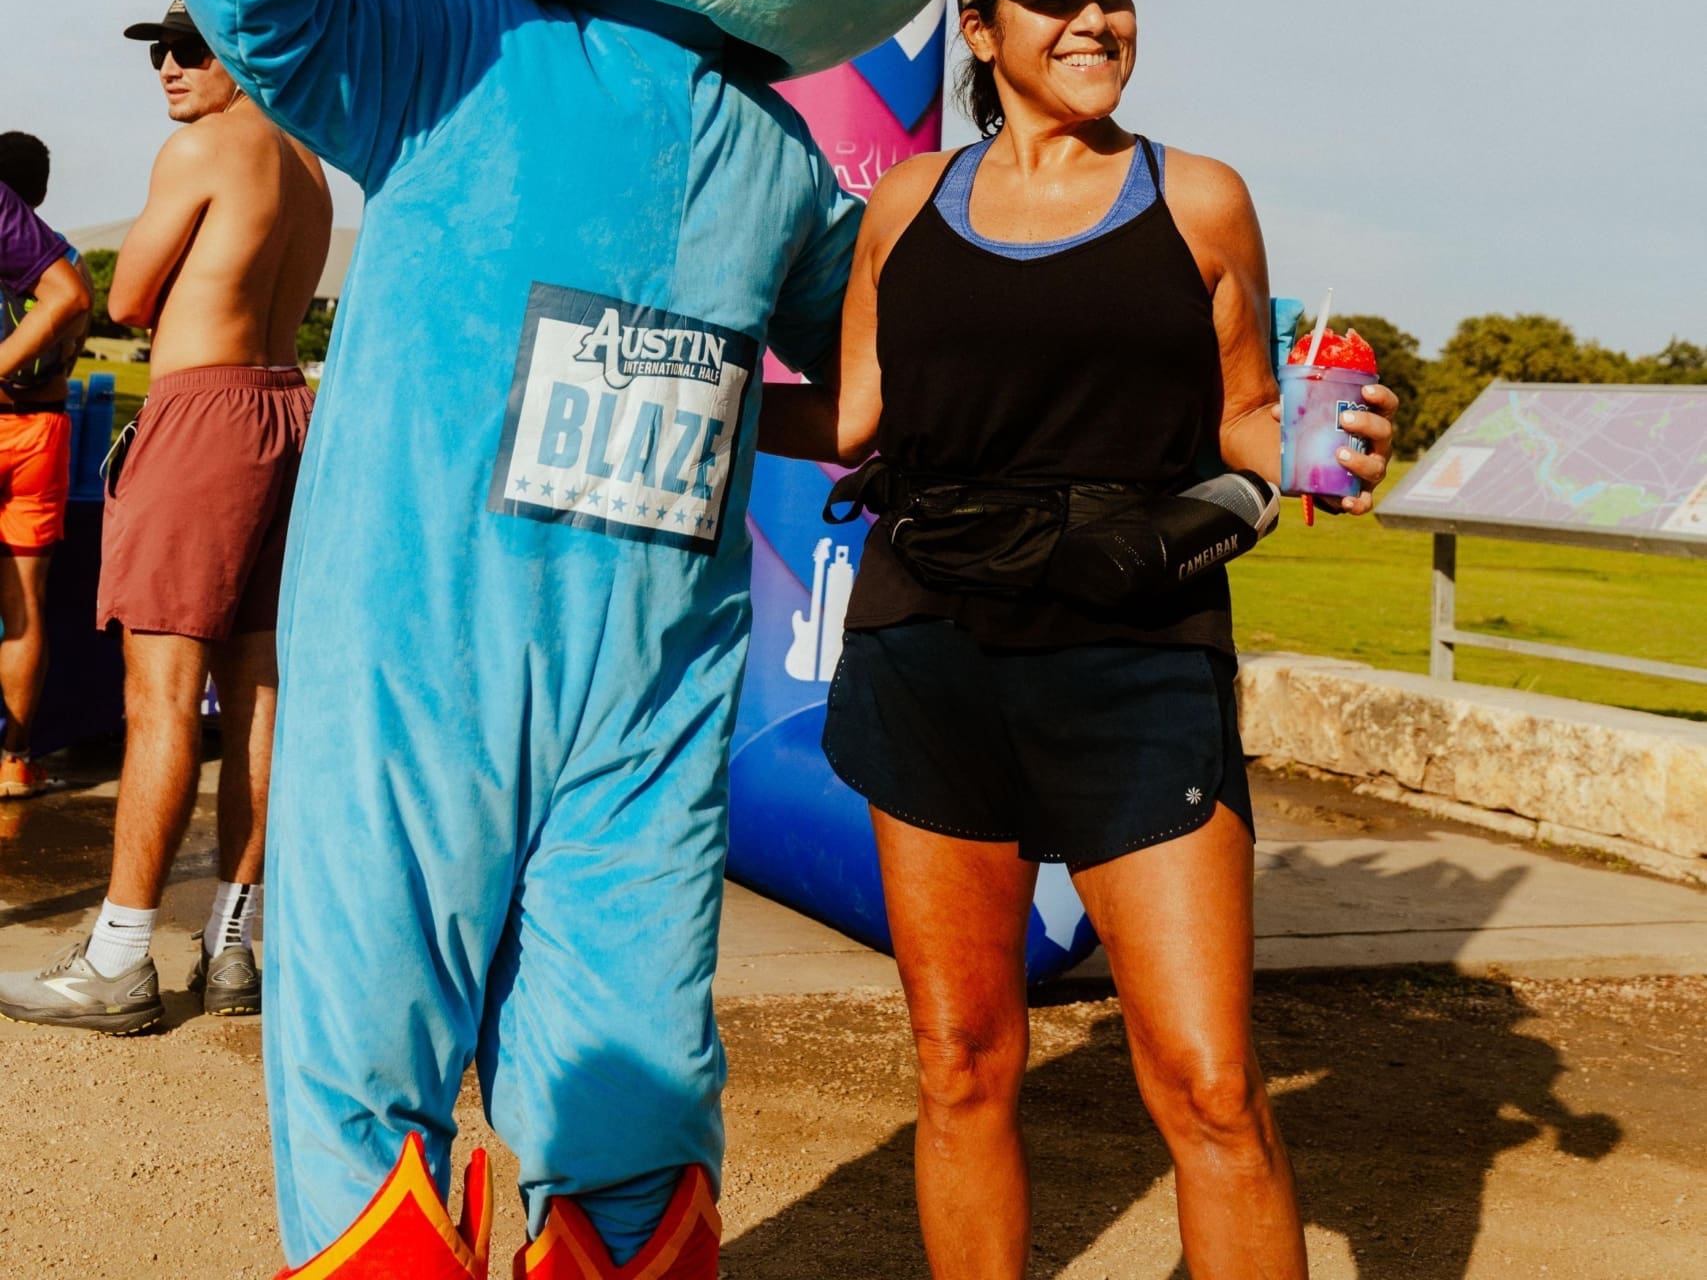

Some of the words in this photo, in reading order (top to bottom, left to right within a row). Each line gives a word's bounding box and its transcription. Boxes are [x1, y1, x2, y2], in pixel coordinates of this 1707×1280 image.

[624, 360, 695, 378] INTERNATIONAL
[699, 368, 721, 383] HALF
[537, 381, 724, 501] BLAZE
[1178, 533, 1238, 581] CAMELBAK
